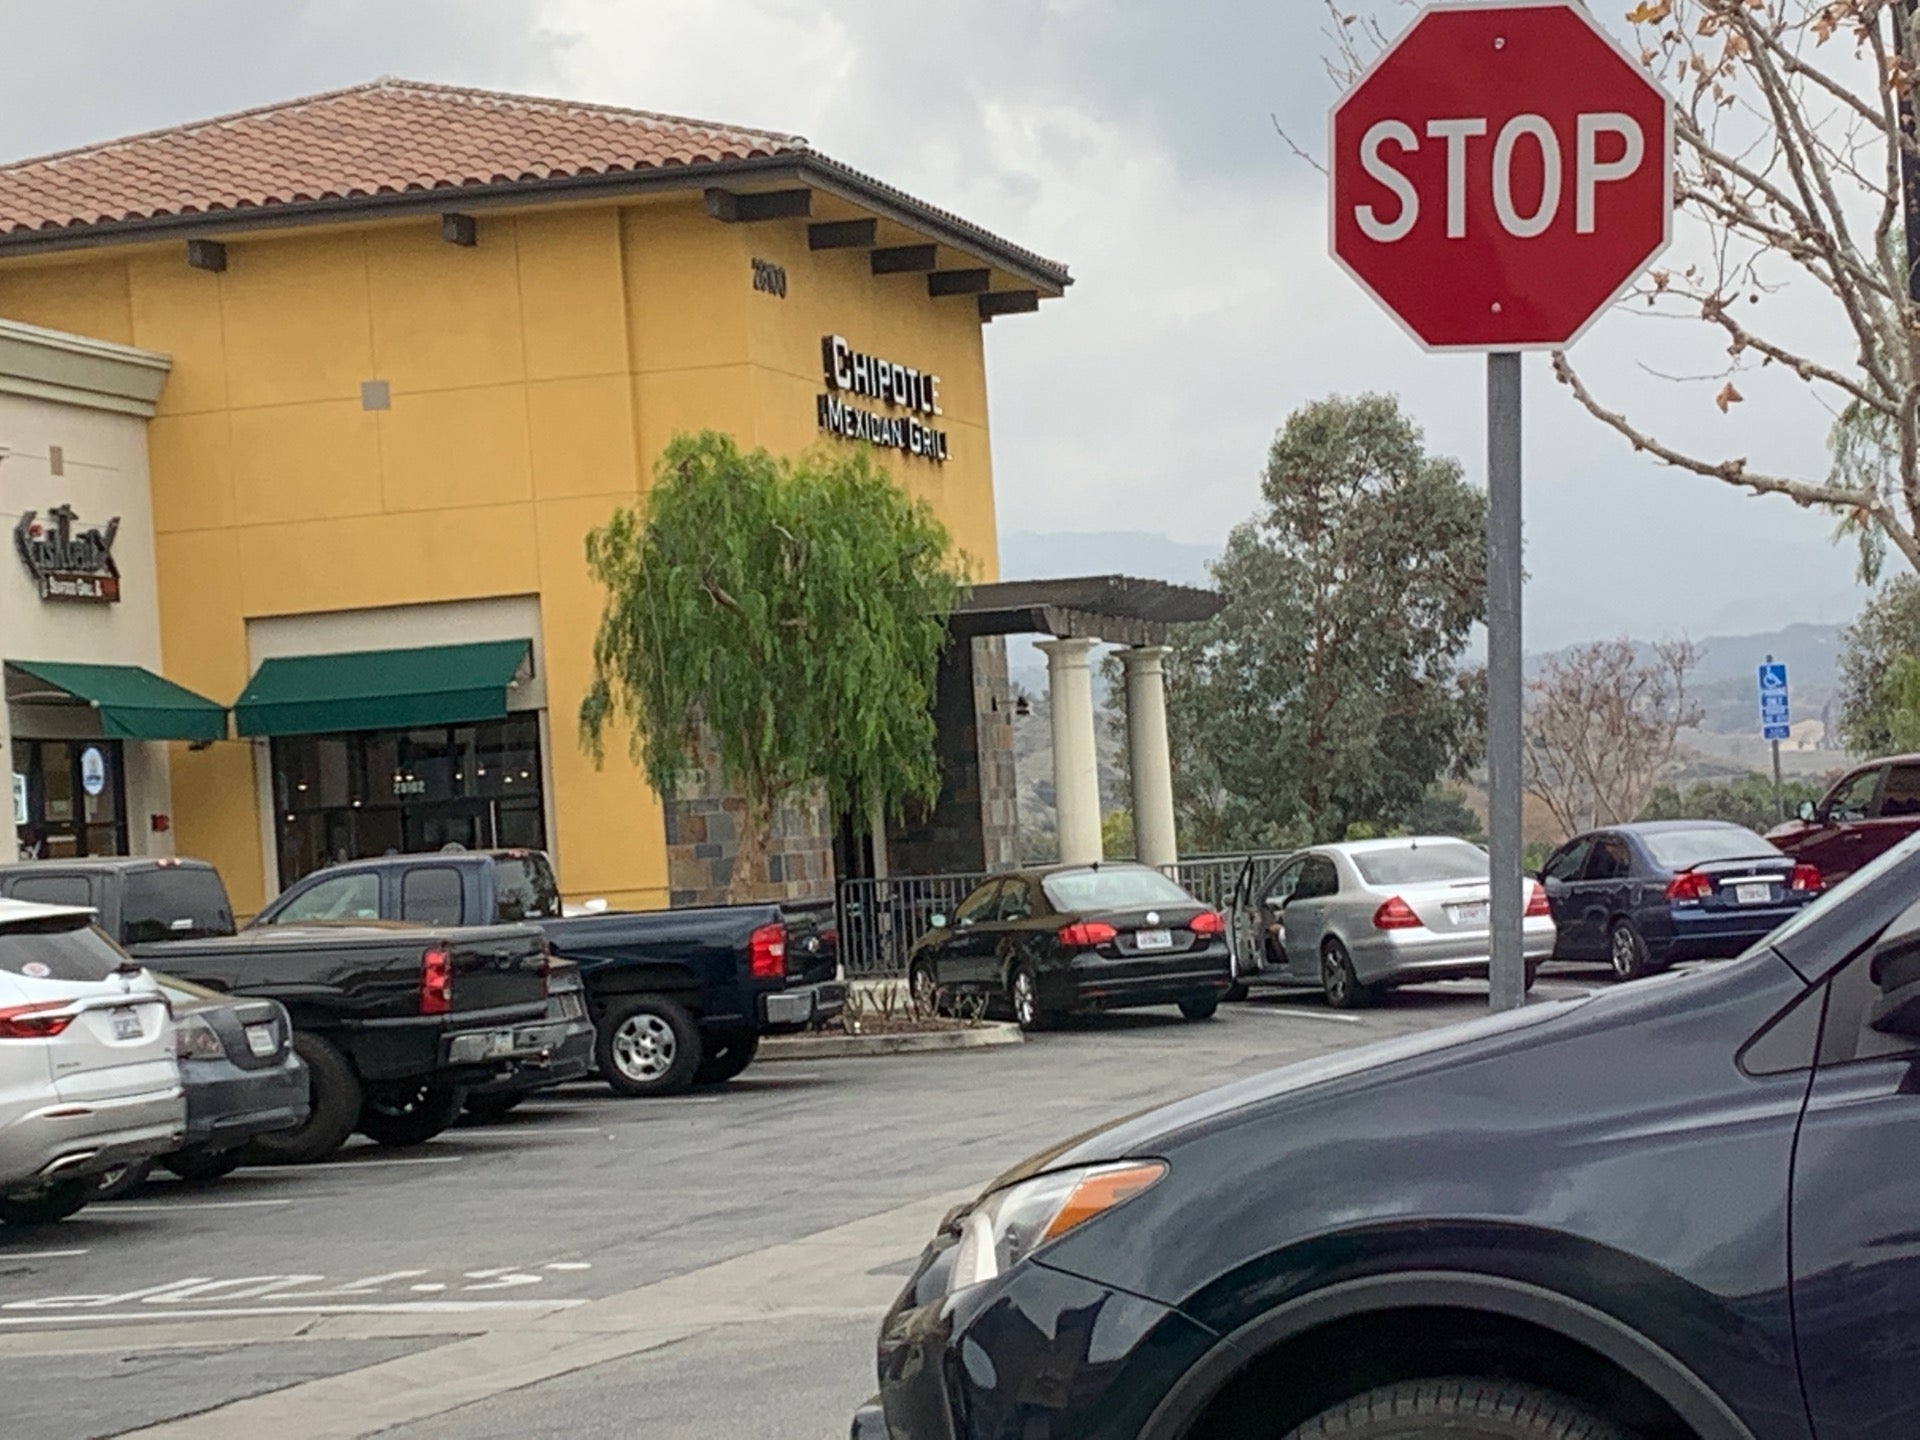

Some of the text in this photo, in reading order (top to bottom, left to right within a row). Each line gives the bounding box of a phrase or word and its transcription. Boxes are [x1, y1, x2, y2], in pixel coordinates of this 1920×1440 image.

[1354, 113, 1645, 243] STOP
[823, 334, 944, 417] CHIPOTLE
[819, 394, 953, 463] MEXICAN GRIL
